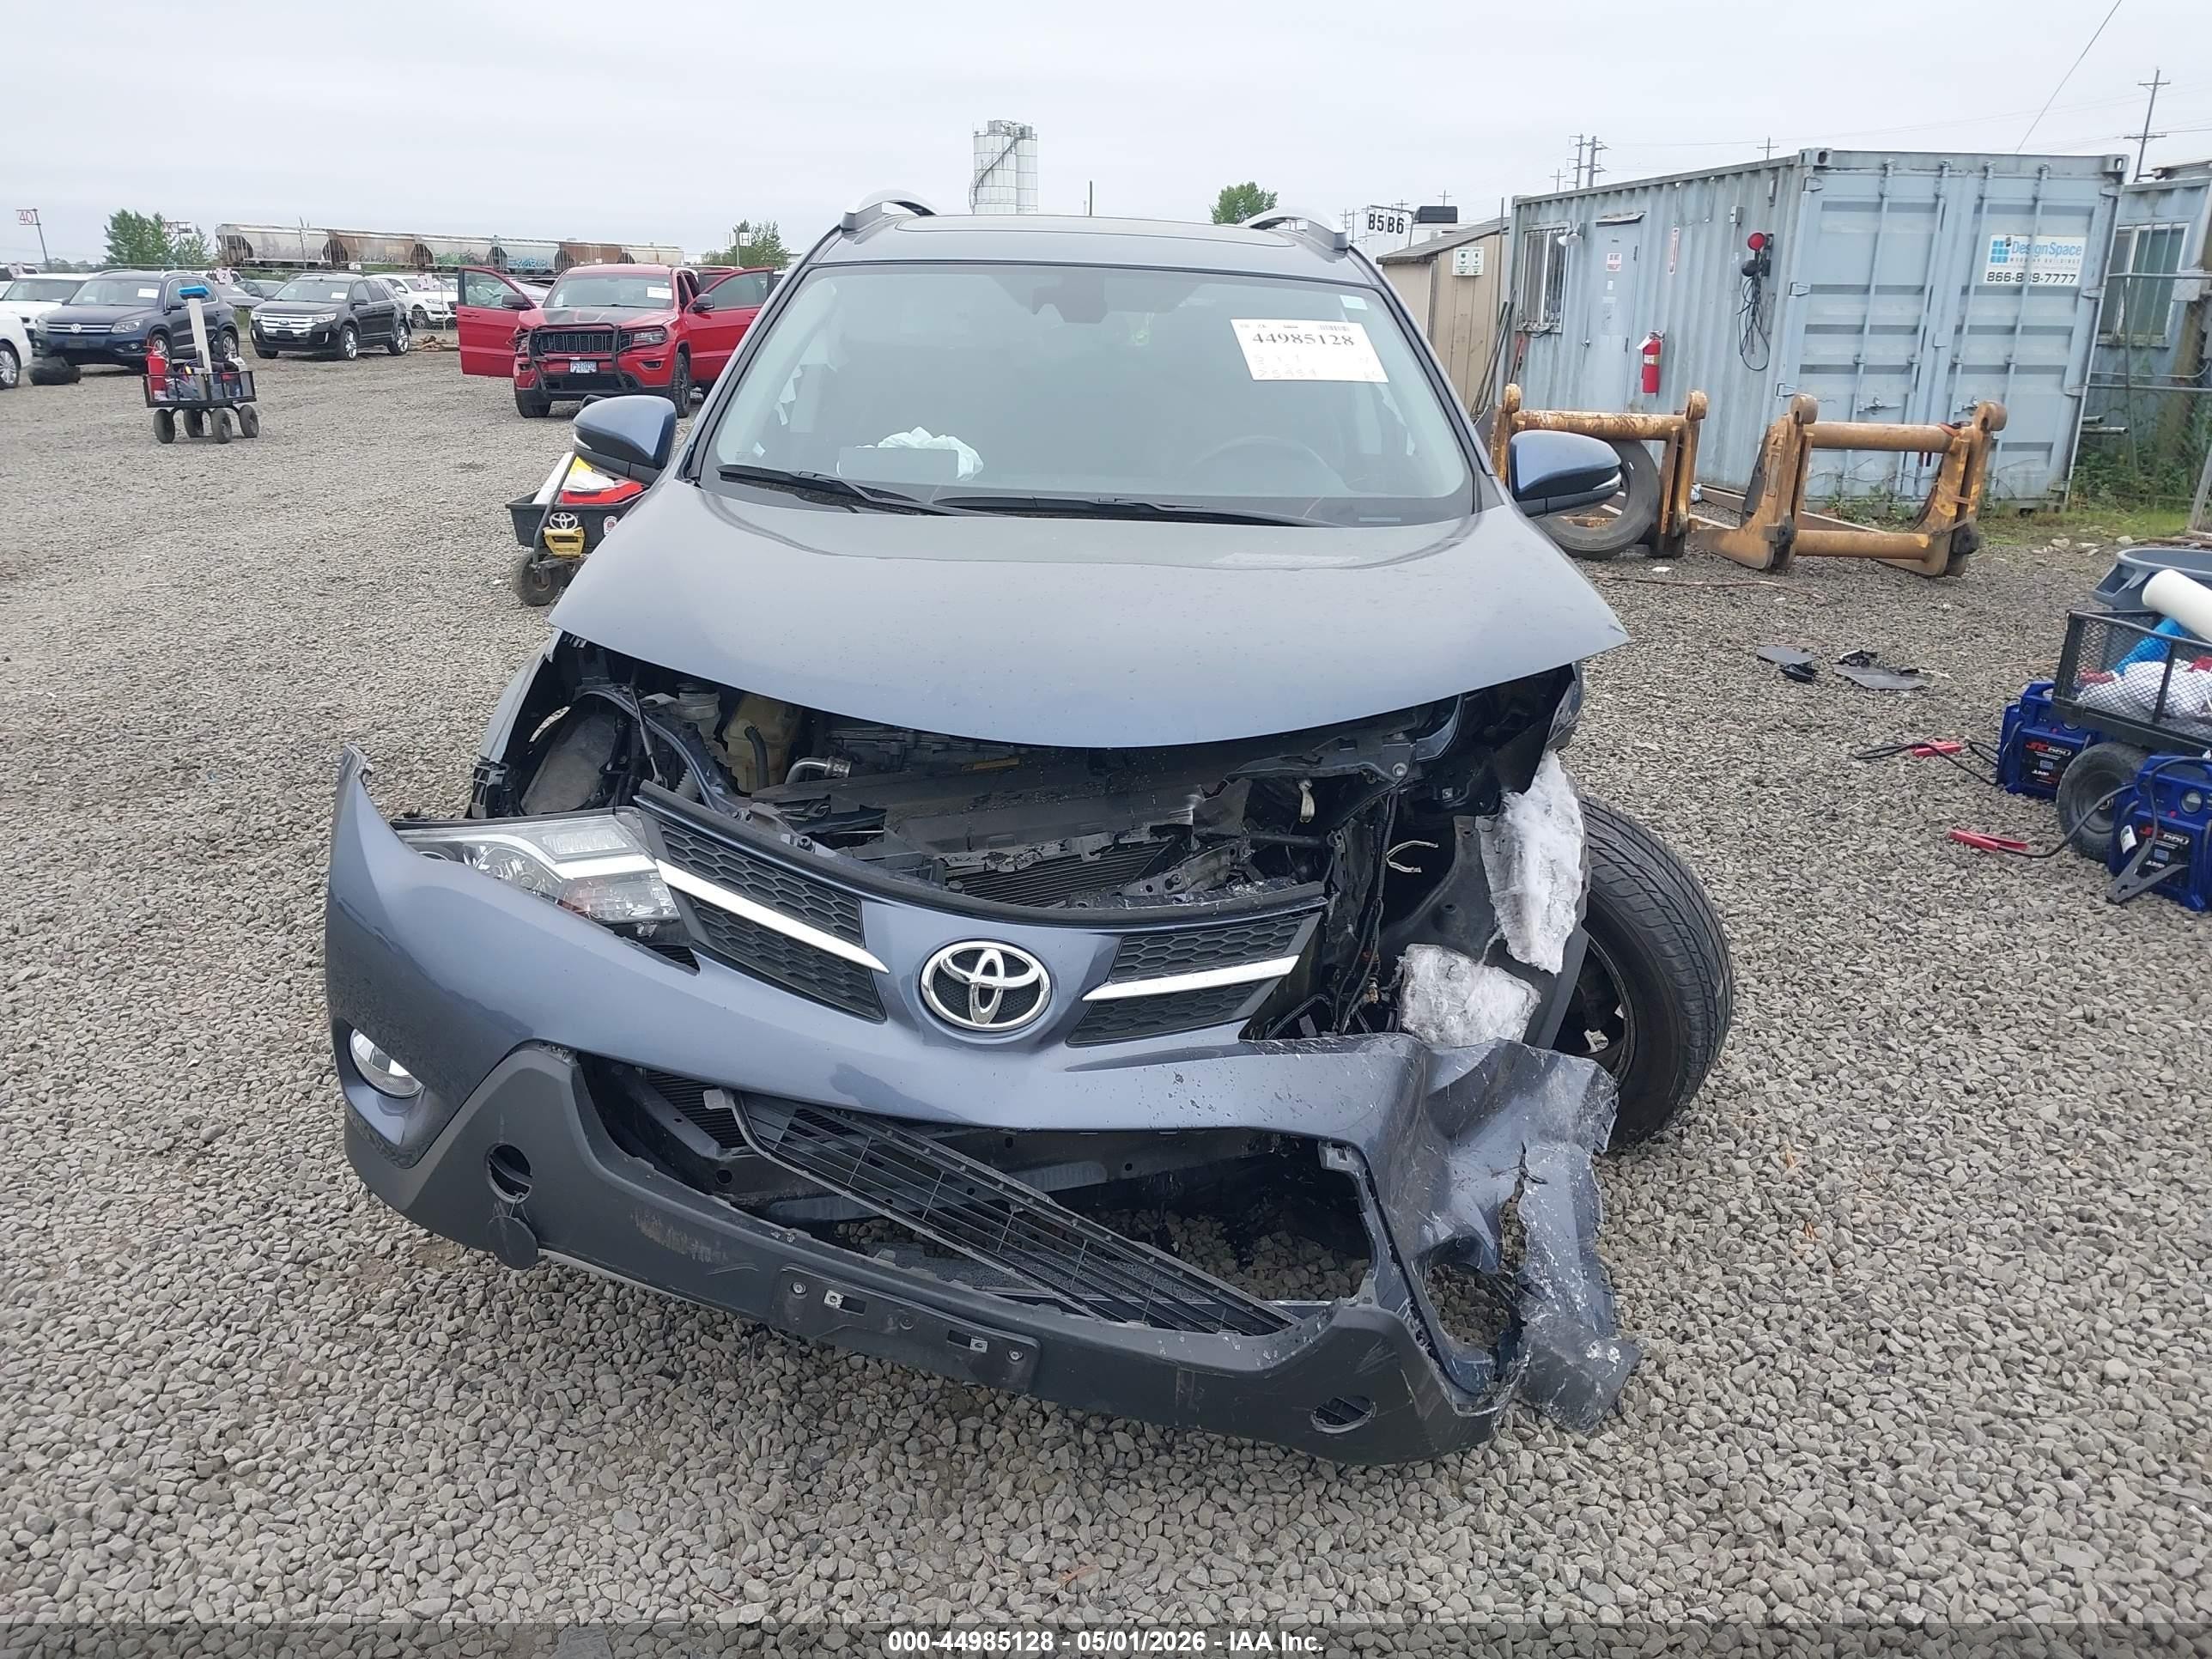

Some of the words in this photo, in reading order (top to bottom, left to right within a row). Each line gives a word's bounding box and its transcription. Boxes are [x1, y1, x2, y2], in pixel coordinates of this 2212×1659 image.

[19, 211, 33, 224] 40
[1368, 213, 1385, 232] B5
[1387, 216, 1405, 234] B6
[2011, 240, 2082, 258] DesgnSpace
[1986, 271, 2077, 283] 866-89-7777
[1252, 333, 1355, 346] 44985128
